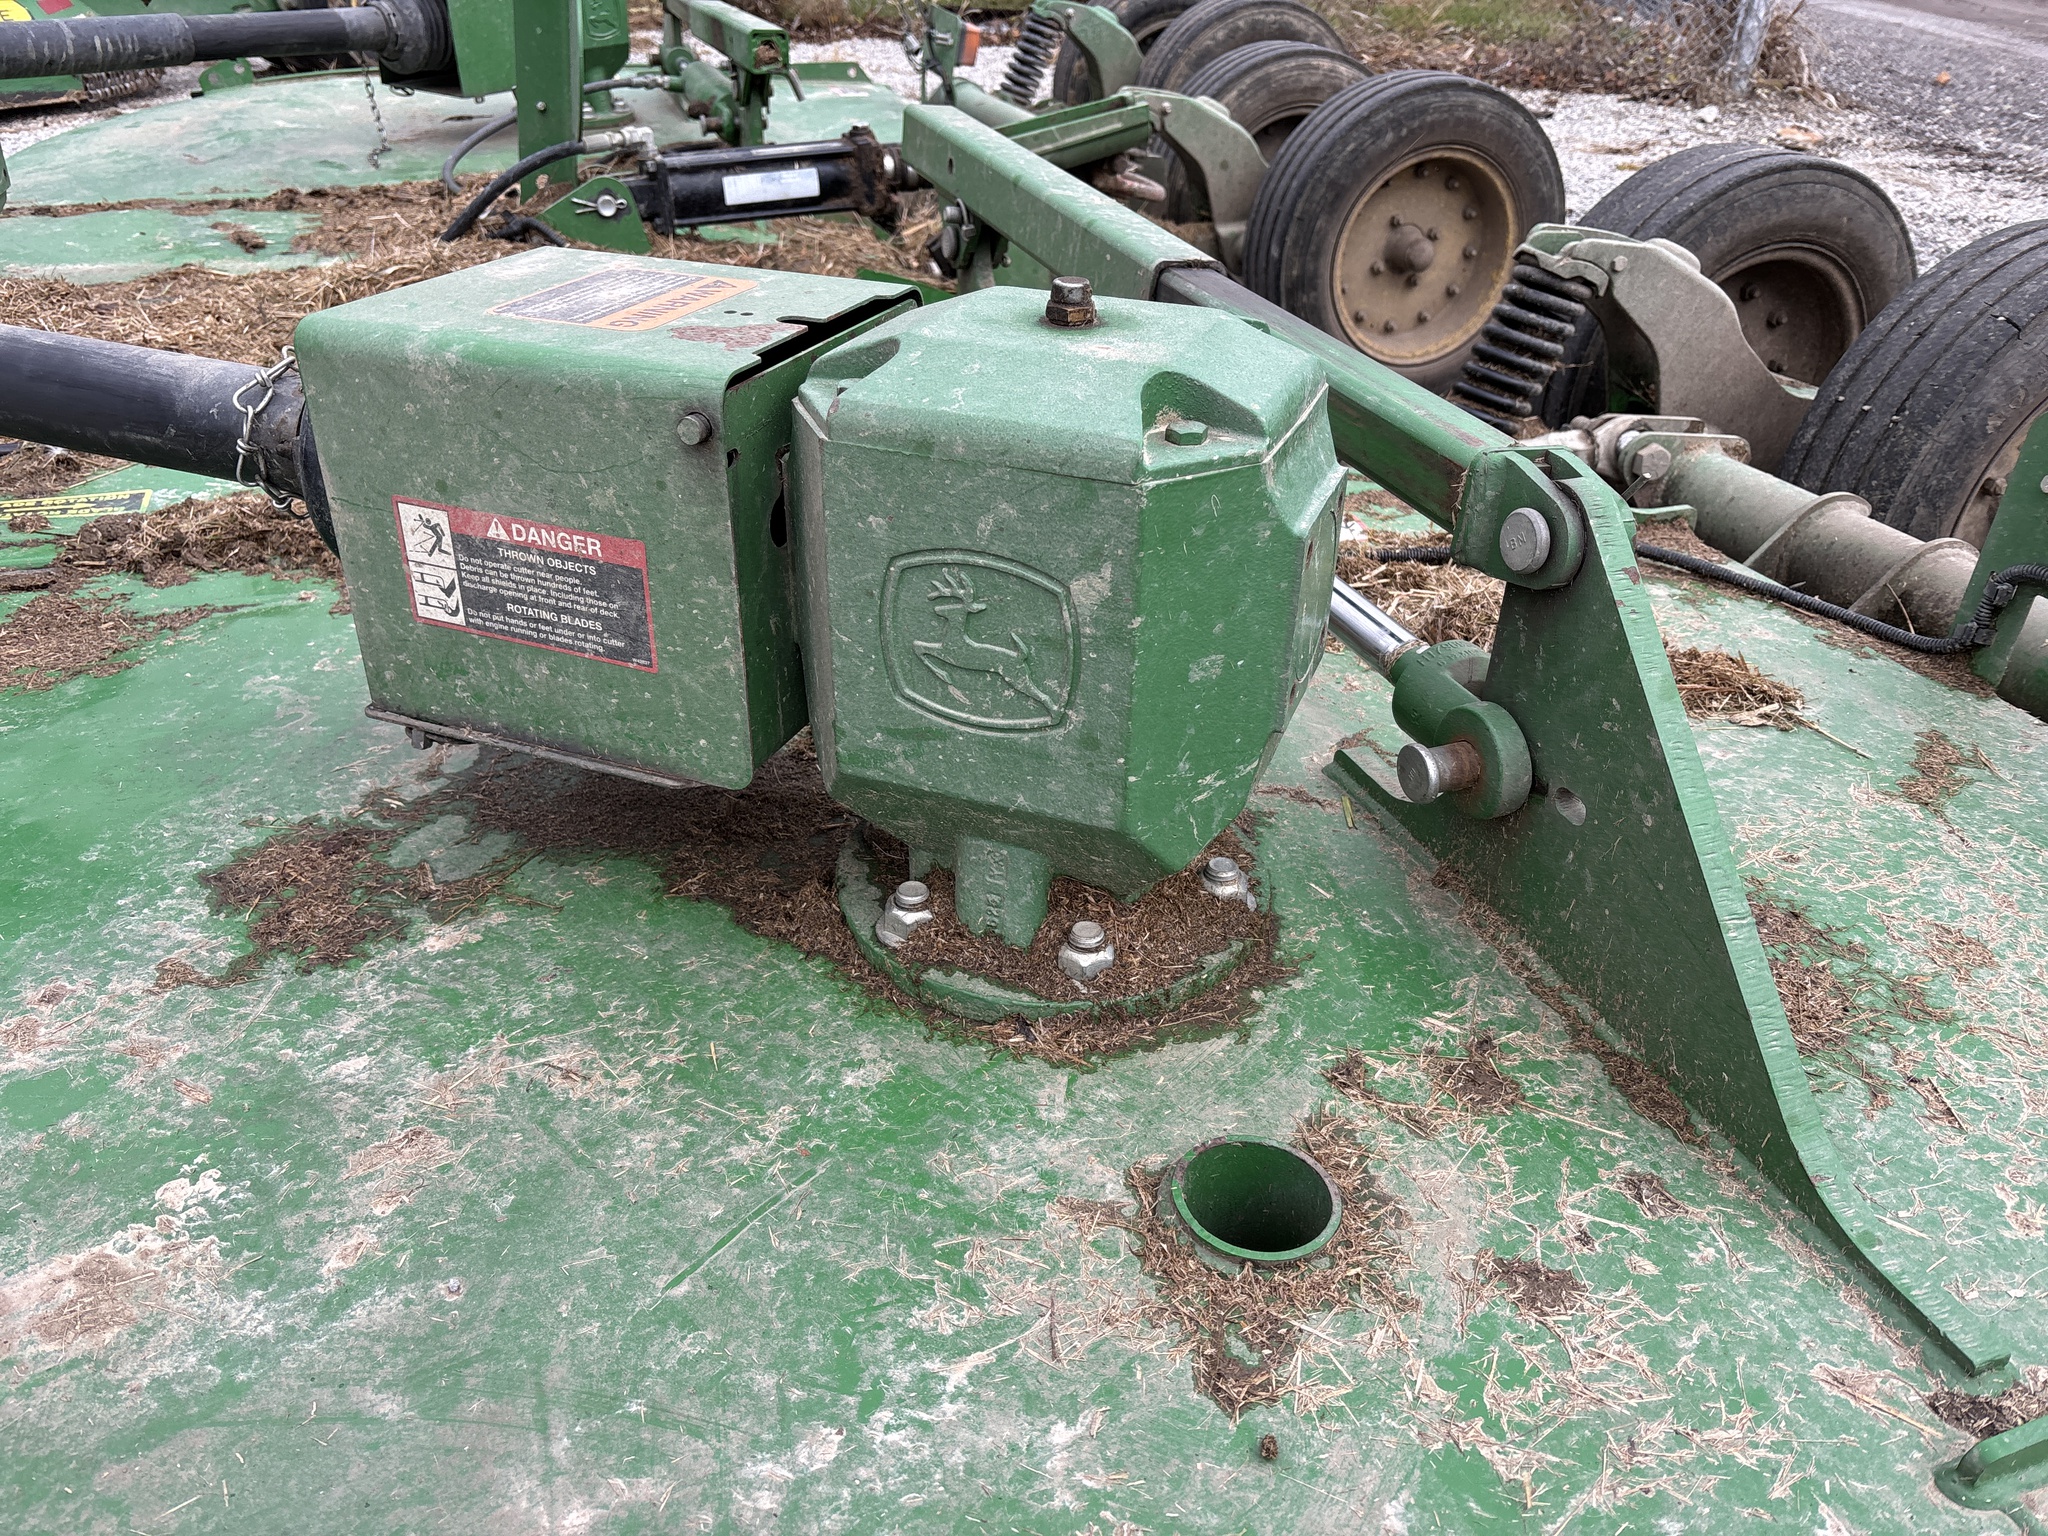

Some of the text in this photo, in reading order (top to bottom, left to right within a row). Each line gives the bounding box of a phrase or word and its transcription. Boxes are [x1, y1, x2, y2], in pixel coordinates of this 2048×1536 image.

[609, 289, 722, 327] WARNING
[41, 494, 130, 506] ROTATION
[510, 522, 602, 557] DANGER
[457, 553, 582, 586] Do not operate cutter near people.
[497, 547, 596, 575] THROWN OBJECTS
[459, 562, 599, 597] Debris can be thrown hundreds of feet.
[460, 571, 480, 582] Keep
[480, 575, 490, 583] all
[490, 577, 516, 588] shields
[585, 597, 607, 607] those
[462, 579, 497, 594] discharge
[498, 587, 528, 600] opening
[538, 595, 556, 605] front
[557, 599, 572, 608] and
[573, 604, 588, 612] rear
[589, 606, 597, 614] of
[599, 608, 620, 618] deck.
[466, 607, 477, 616] Do
[478, 610, 491, 619] not
[491, 613, 504, 623] put
[505, 615, 527, 627] hands
[537, 622, 552, 632] feet
[554, 626, 575, 637] under
[586, 633, 601, 642] into
[602, 636, 625, 648] cutter
[468, 615, 605, 652] with engine running or blades rotating.
[506, 603, 602, 631] ROTATING BLADES
